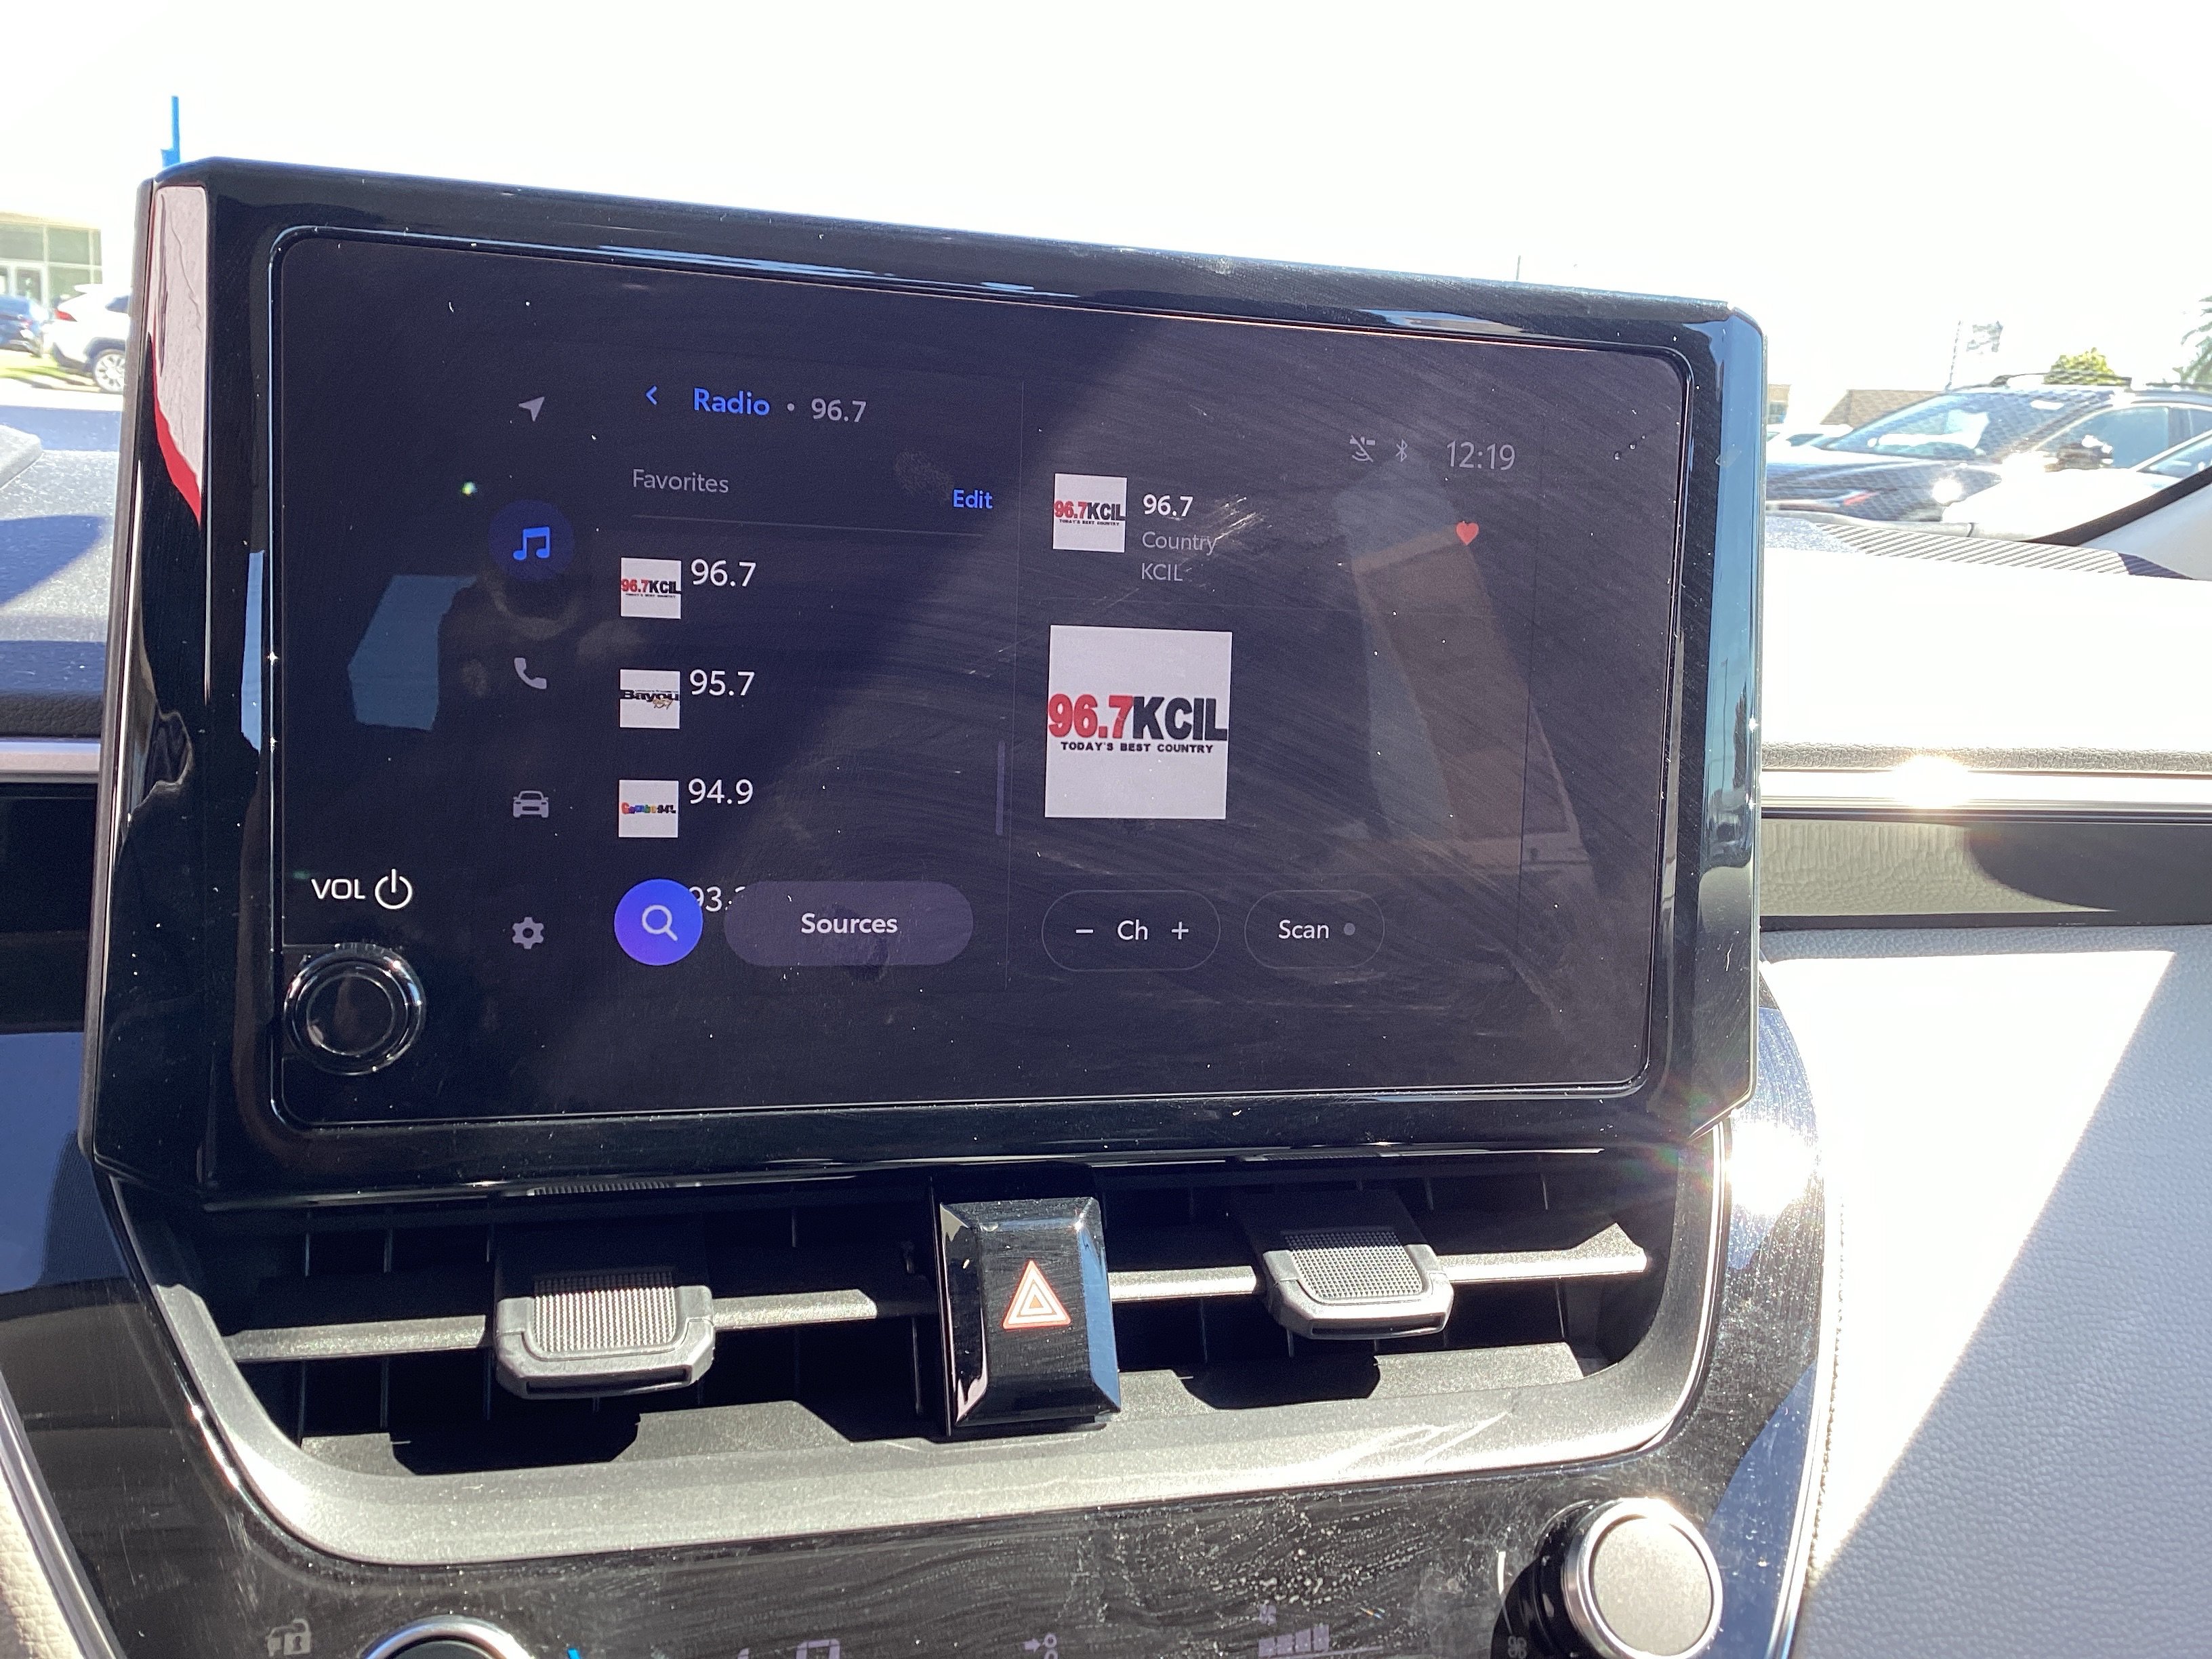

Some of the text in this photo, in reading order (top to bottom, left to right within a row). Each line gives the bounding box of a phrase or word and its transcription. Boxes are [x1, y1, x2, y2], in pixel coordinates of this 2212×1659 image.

[693, 388, 867, 422] Radio 96.7
[1446, 440, 1515, 470] 12:19
[633, 469, 729, 493] Favorites
[953, 489, 993, 509] Edit
[1143, 493, 1193, 517] 96.7
[1142, 531, 1217, 556] Country
[691, 558, 756, 588] 96.7
[1141, 562, 1183, 581] KCIL
[689, 669, 755, 696] 95.7
[1061, 741, 1213, 754] TODAY'S BEST COUNTRY
[688, 778, 754, 804] 94.9
[310, 879, 366, 900] VOL
[801, 912, 898, 934] Sources
[1117, 919, 1149, 941] Ch
[1278, 919, 1330, 939] Scan
